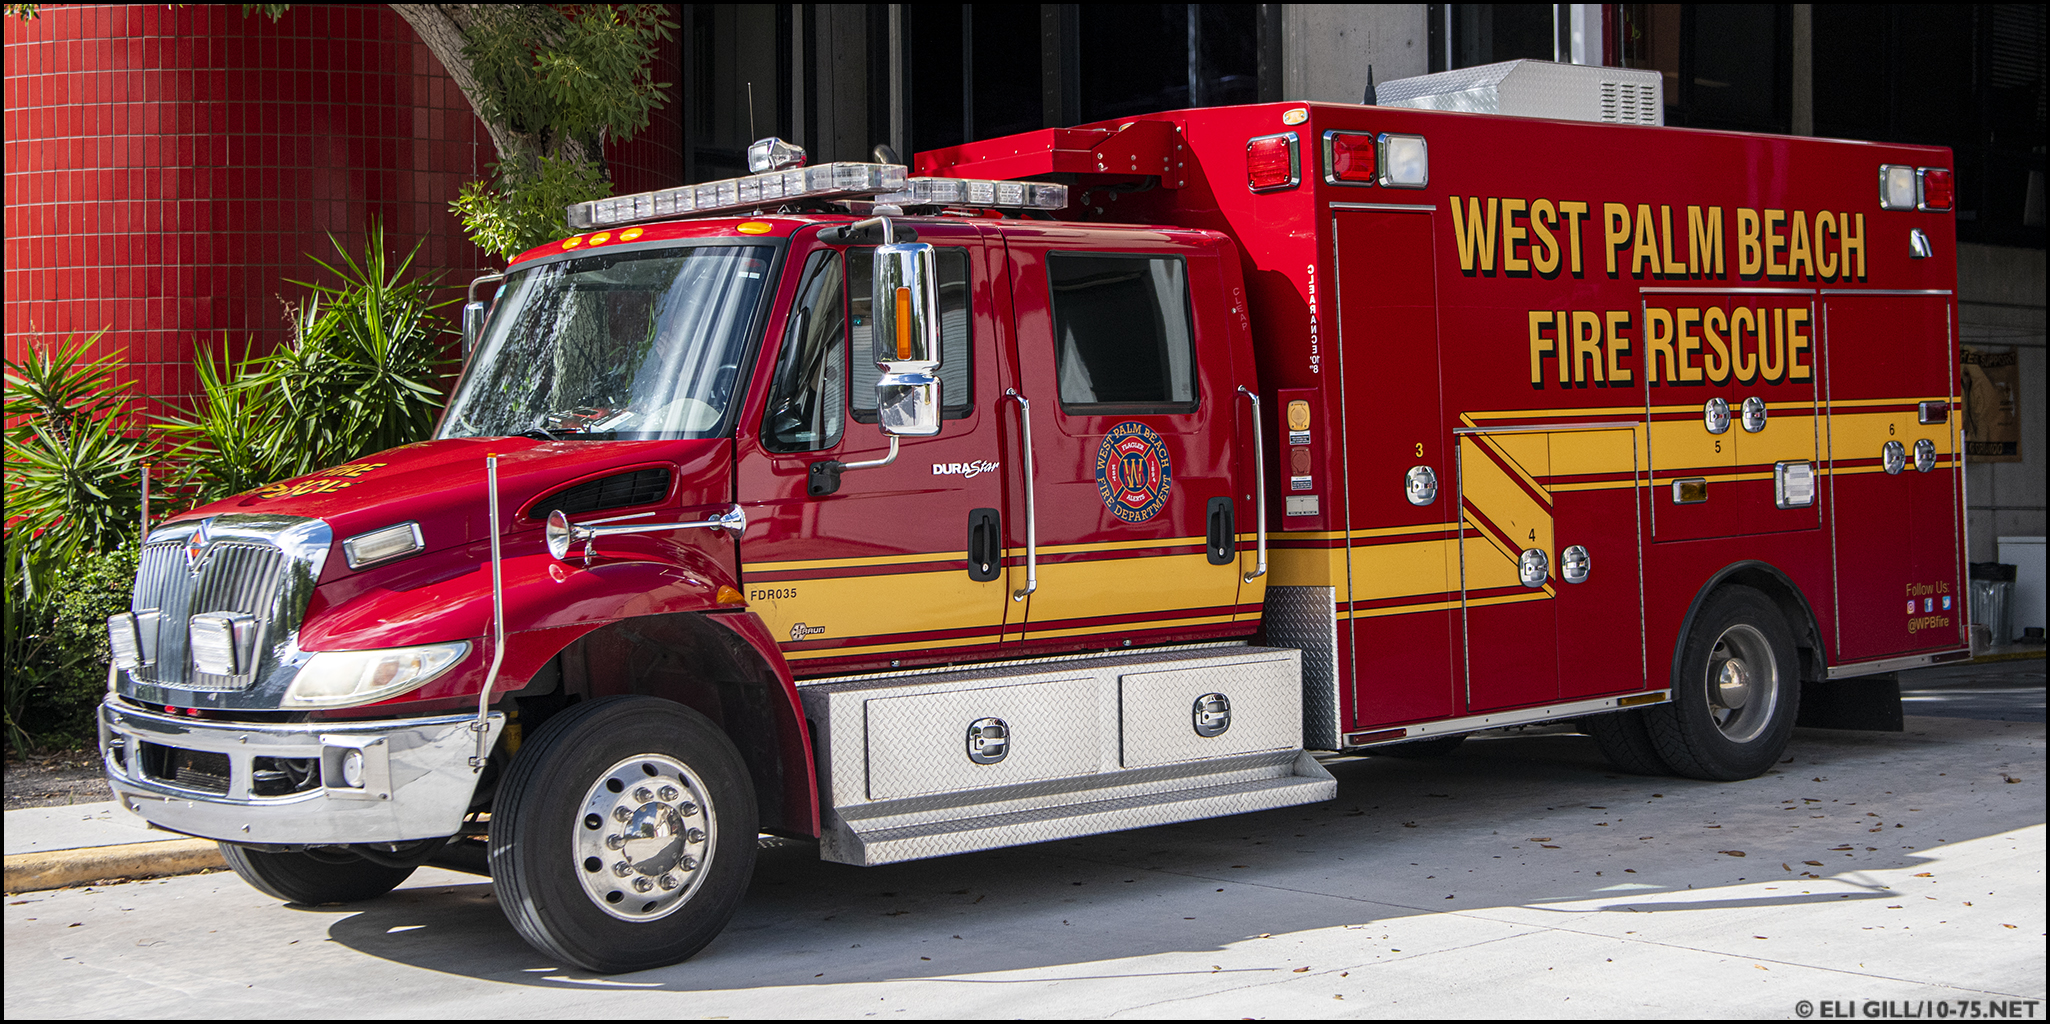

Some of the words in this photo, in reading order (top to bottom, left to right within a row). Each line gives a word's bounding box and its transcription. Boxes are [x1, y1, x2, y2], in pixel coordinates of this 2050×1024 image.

[1449, 195, 1590, 277] WEST
[1604, 201, 1725, 278] PALM
[1737, 207, 1868, 281] BEACH
[1528, 310, 1634, 387] FIRE
[1647, 306, 1812, 385] RESCUE
[1889, 423, 1895, 436] 6
[1097, 434, 1114, 470] WEST
[1113, 423, 1142, 439] PALM
[1143, 427, 1169, 468] BEACH
[1121, 442, 1145, 451] FLAGLER
[1415, 442, 1424, 458] 3
[1715, 440, 1721, 453] 5
[1097, 476, 1115, 508] FIRE
[1113, 474, 1171, 522] DEPARTMENT
[1528, 528, 1536, 542] 4
[750, 588, 797, 601] FDR035
[1906, 582, 1934, 597] Follow
[1935, 580, 1950, 594] Us:
[1907, 615, 1950, 634] @WPBfire
